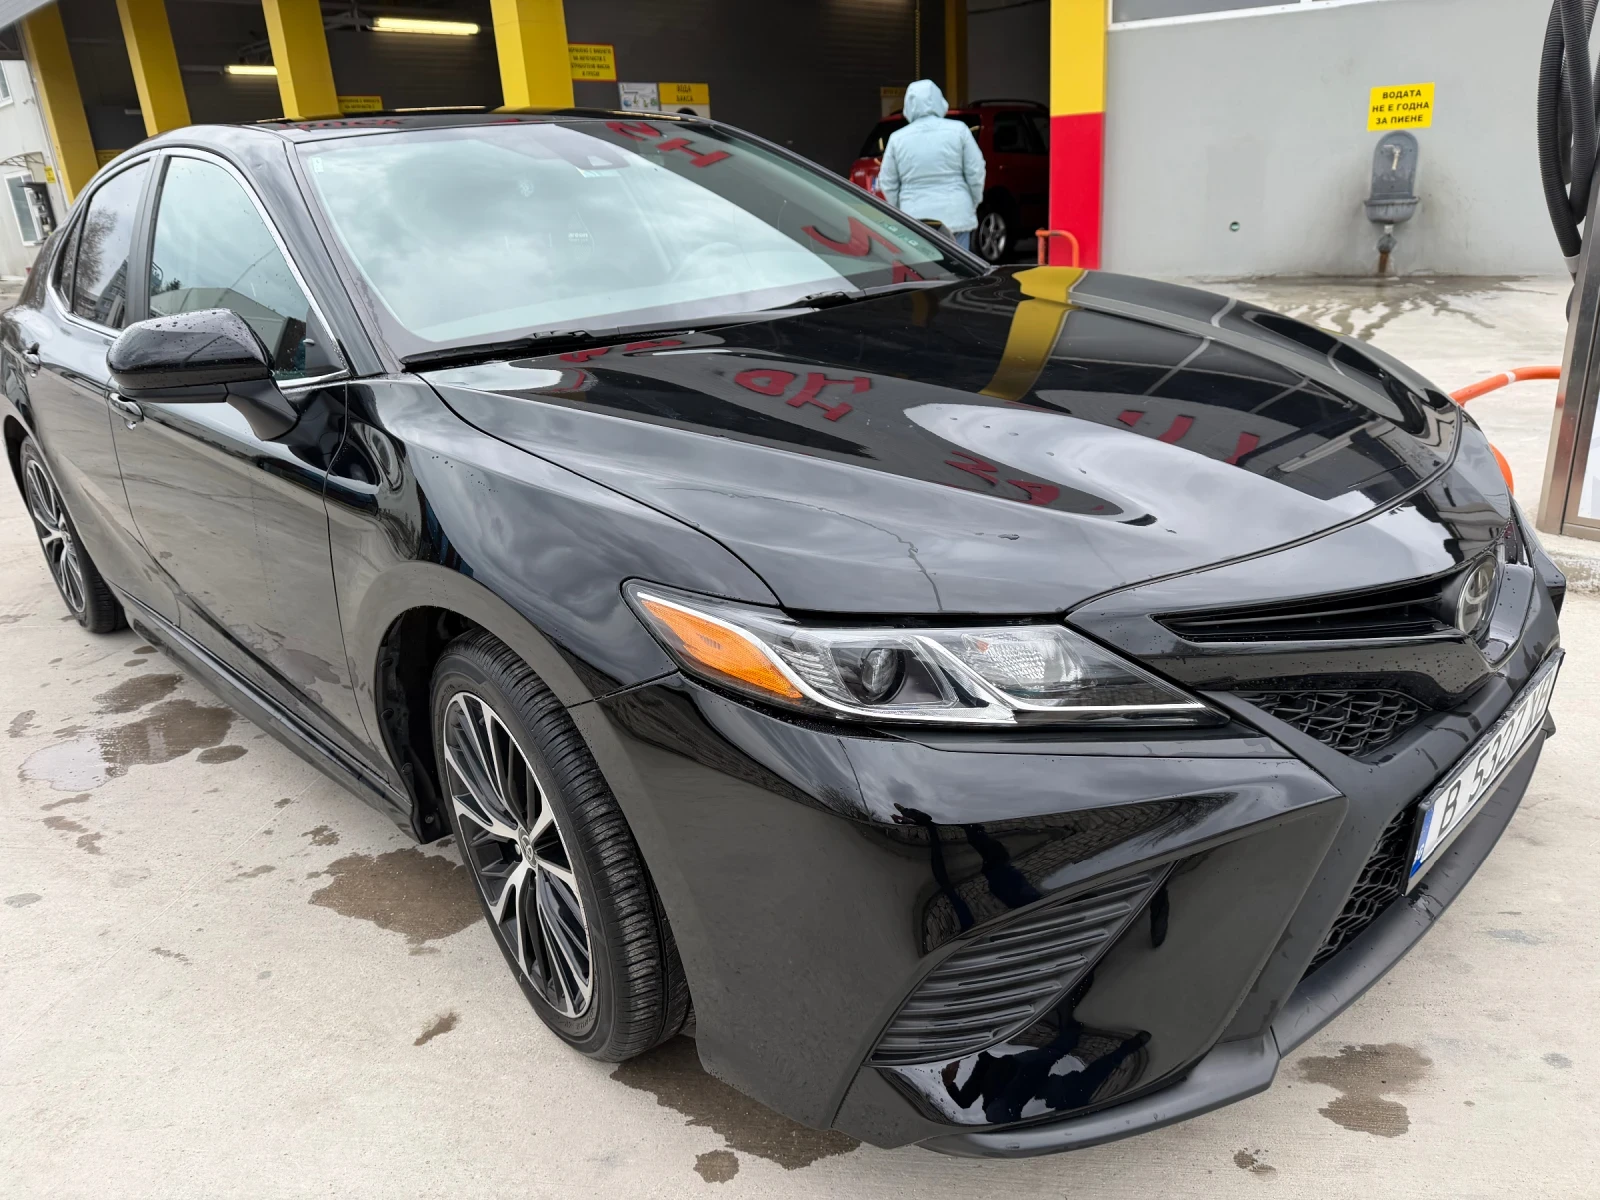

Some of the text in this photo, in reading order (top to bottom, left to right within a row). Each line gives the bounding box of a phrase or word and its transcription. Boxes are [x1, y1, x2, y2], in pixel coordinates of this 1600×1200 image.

[1382, 90, 1421, 99] ВОДАТА
[1388, 104, 1393, 112] Е
[1396, 102, 1429, 111] ГОДНА
[1375, 114, 1423, 125] ЗА ПИЕНЕ
[1468, 700, 1529, 803] 5327
